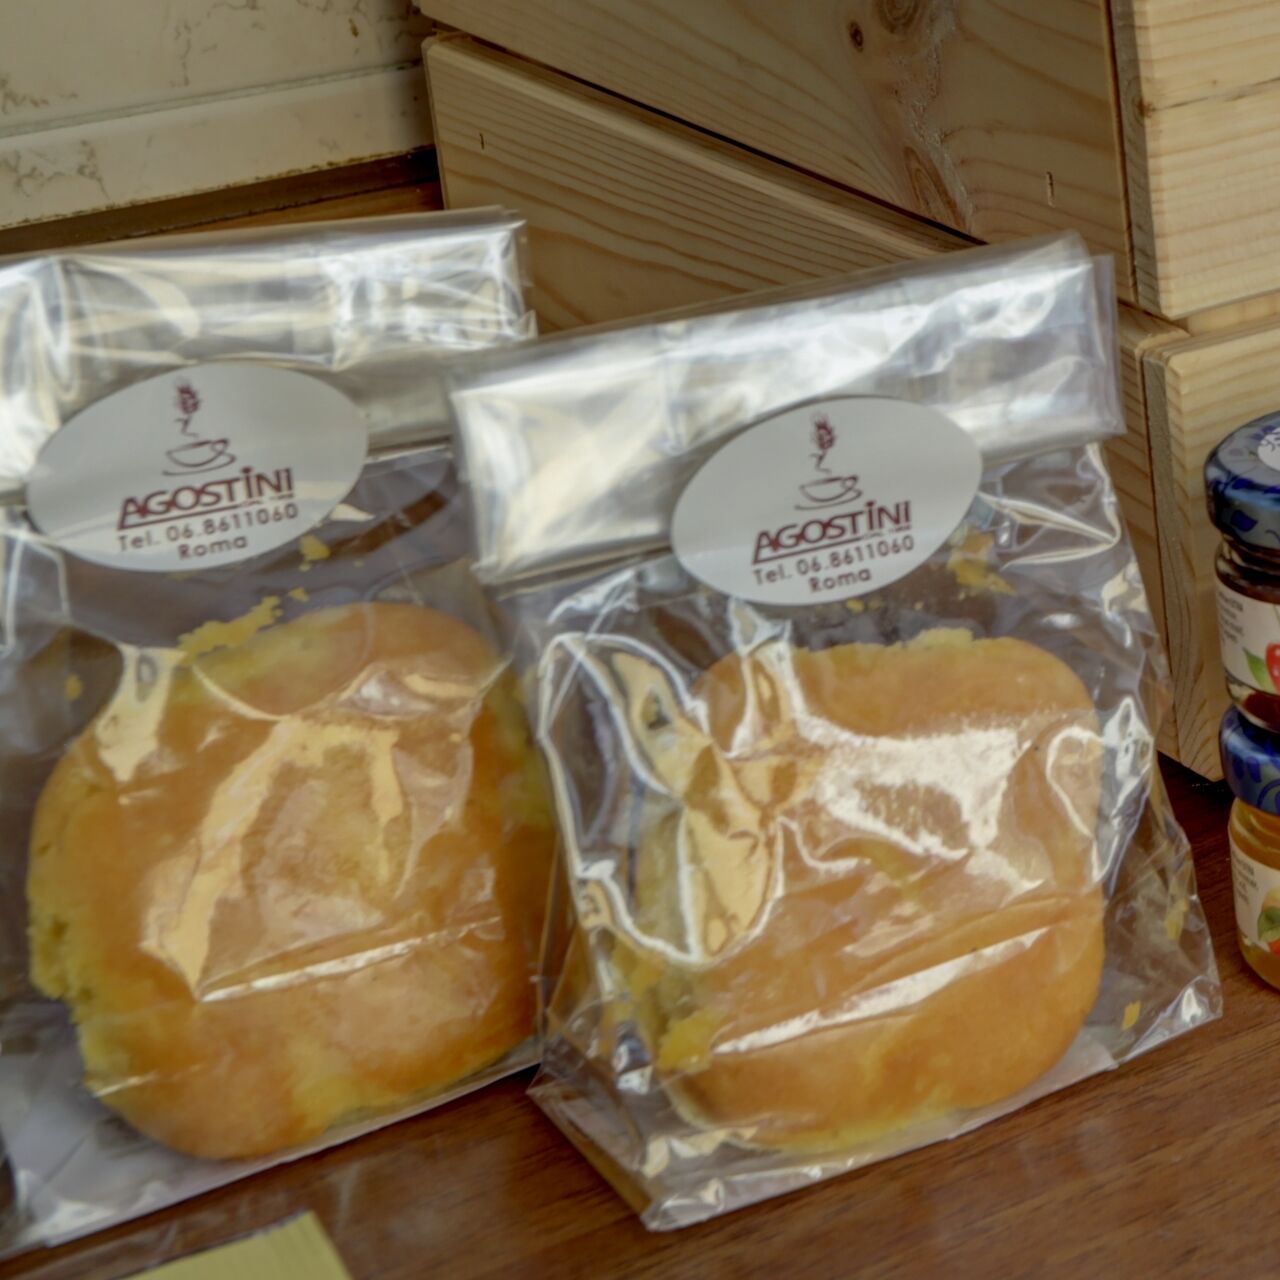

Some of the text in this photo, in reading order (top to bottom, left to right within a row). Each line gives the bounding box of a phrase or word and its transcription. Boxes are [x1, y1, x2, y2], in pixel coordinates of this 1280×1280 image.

[118, 503, 298, 551] Tel. 06.8611060
[178, 536, 248, 560] Roma
[754, 535, 915, 585] Tel. 06.8611060
[808, 568, 872, 593] Roma
